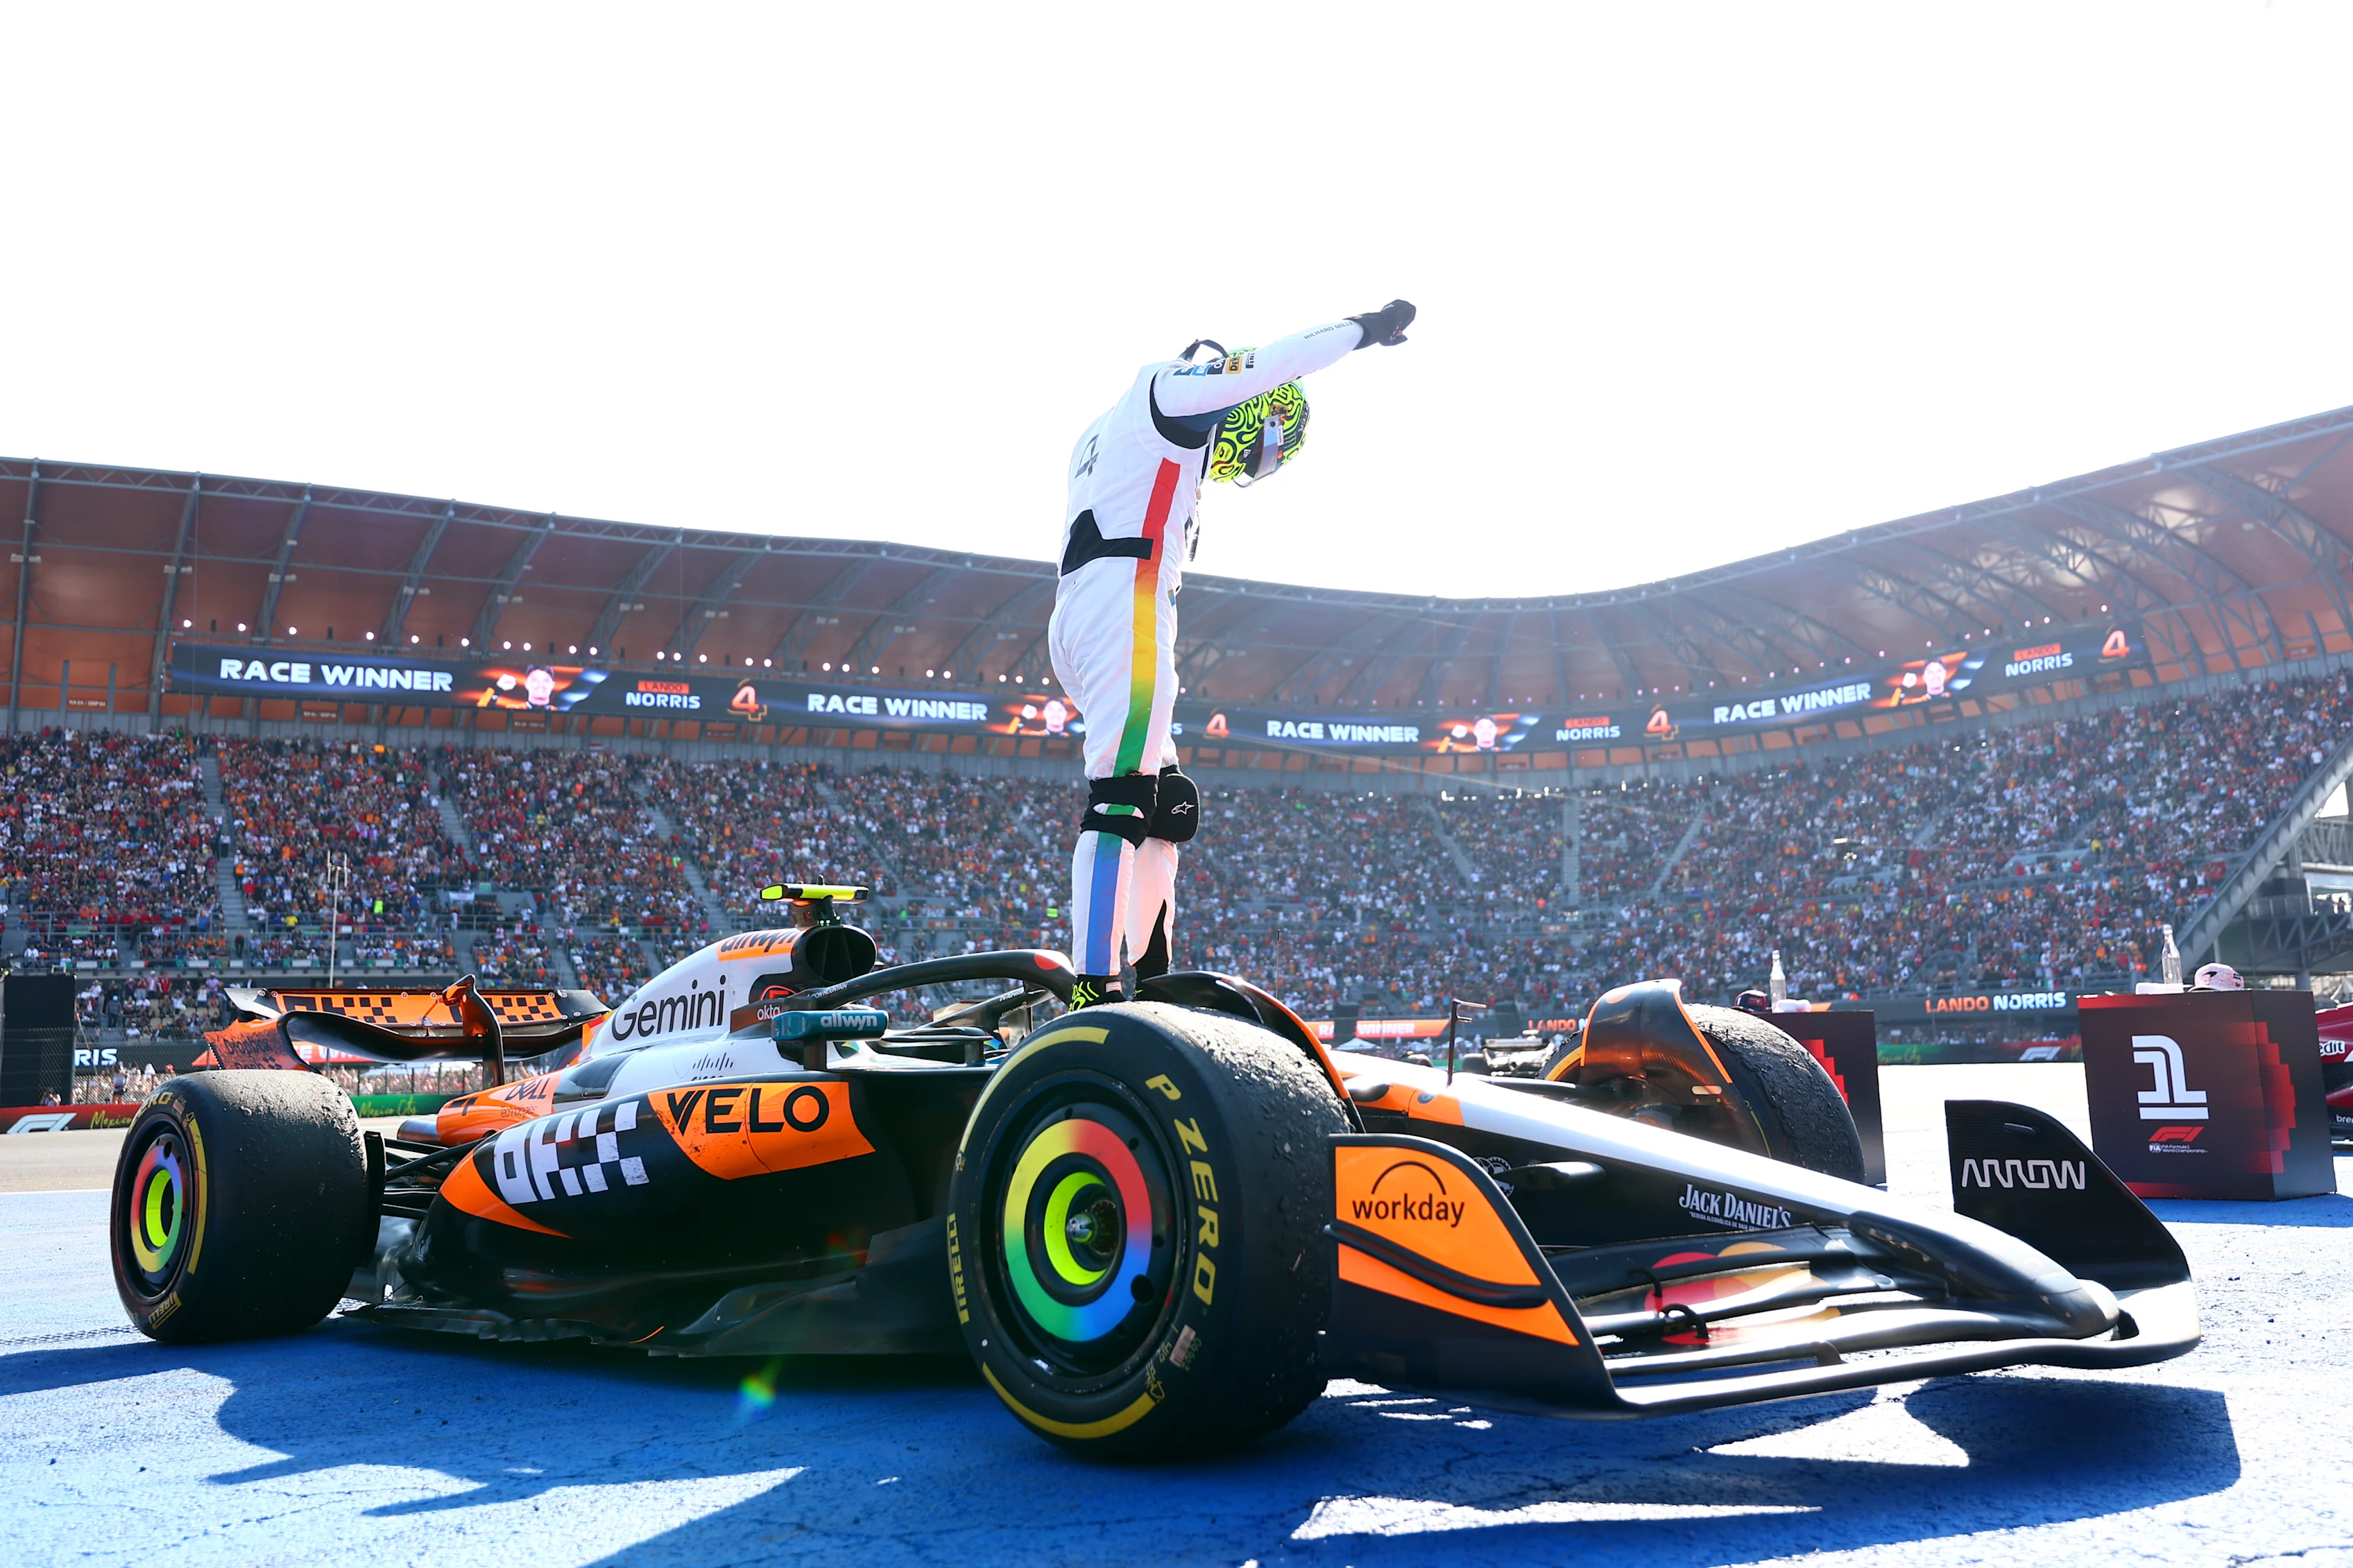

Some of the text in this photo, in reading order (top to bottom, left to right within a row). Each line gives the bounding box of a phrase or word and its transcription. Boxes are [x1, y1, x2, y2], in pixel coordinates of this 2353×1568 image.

[1303, 321, 1354, 340] RICHARD MILLE
[2019, 644, 2057, 660] LANDO
[2101, 629, 2130, 659] 4
[220, 657, 454, 692] RACE WINNER
[2005, 653, 2073, 678] NORRIS
[640, 681, 685, 693] LANDO
[731, 685, 760, 714] 4
[625, 691, 701, 709] NORRIS
[807, 693, 989, 721] RACE WINNER
[1713, 682, 1872, 725] RACE WINNER
[1206, 712, 1231, 739] 4
[1266, 719, 1420, 743] RACE WINNER
[1555, 725, 1622, 742] NORRIS
[1646, 709, 1671, 734] 4
[720, 930, 800, 953] allwyn
[611, 974, 726, 1041] Gemini
[757, 1003, 781, 1021] okta
[1924, 992, 2067, 1014] LANDO NORRIS
[820, 1013, 878, 1031] allwyn
[1356, 1022, 1416, 1035] WINNER
[223, 1036, 273, 1058] Dropbox
[2131, 1035, 2209, 1110] 1
[504, 1077, 551, 1101] DELL
[500, 1104, 538, 1119] Technologies
[666, 1084, 830, 1136] VELO
[1145, 1074, 1220, 1307] P ZERO
[1351, 1193, 1465, 1227] workday
[1678, 1182, 1791, 1229] JACK DANIEL'S
[946, 1212, 970, 1325] PIRELLI
[148, 1291, 183, 1330] PIRELLI
